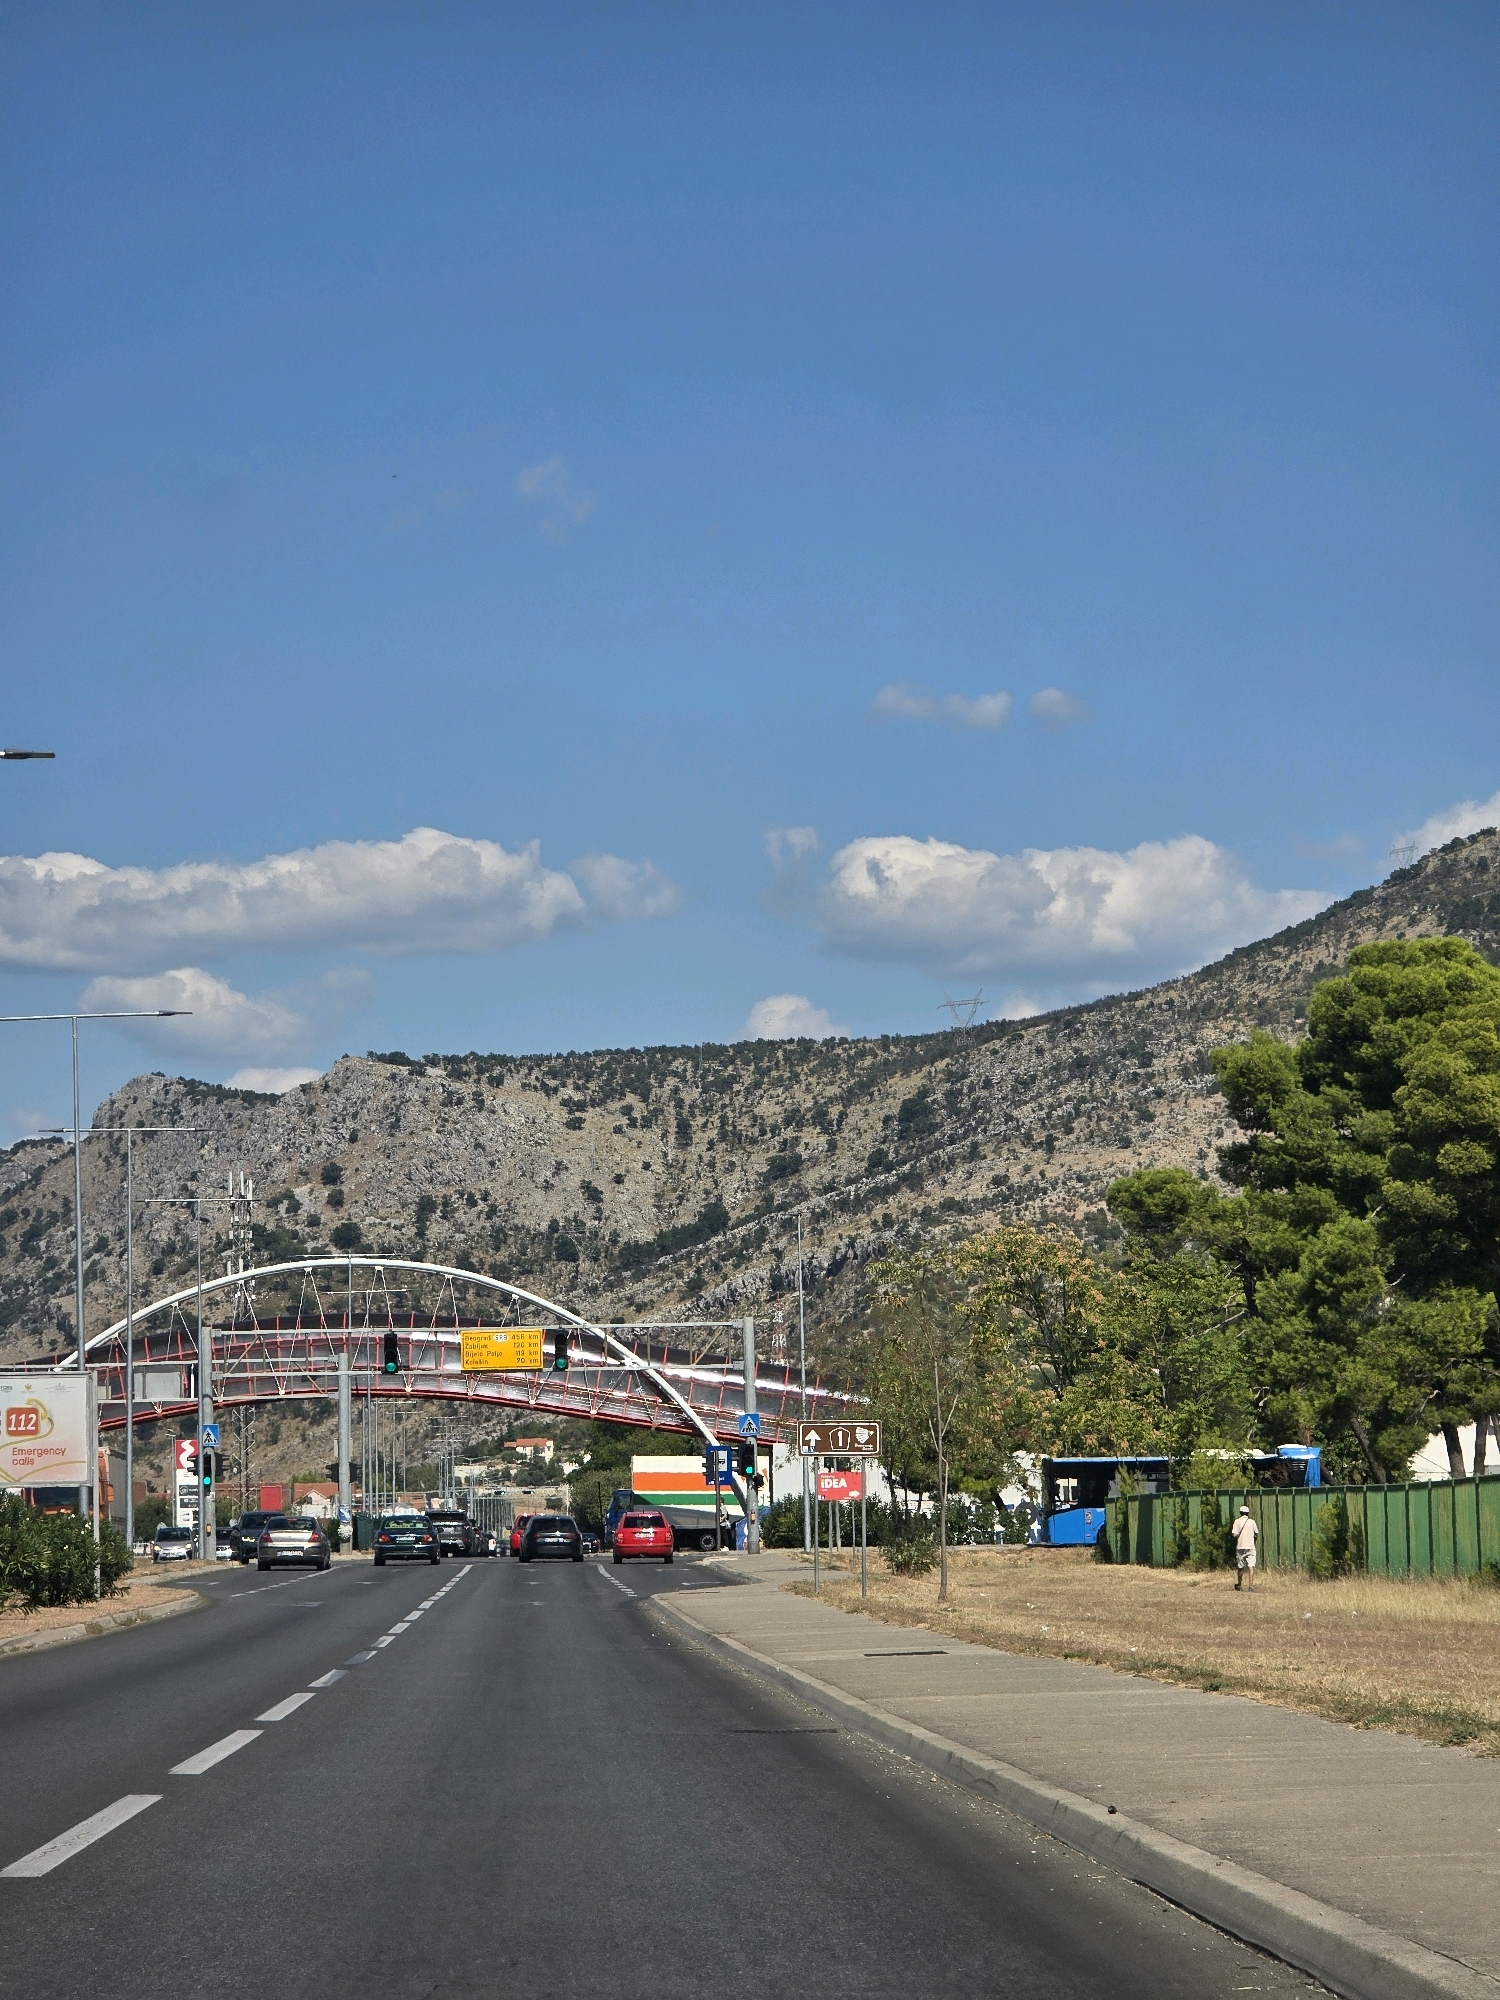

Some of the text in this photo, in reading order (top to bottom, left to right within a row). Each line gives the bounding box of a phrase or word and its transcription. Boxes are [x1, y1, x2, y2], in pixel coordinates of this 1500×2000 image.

[8, 1414, 37, 1431] 112
[838, 1431, 842, 1446] 1
[12, 1447, 66, 1457] Emergency
[12, 1457, 34, 1465] calls
